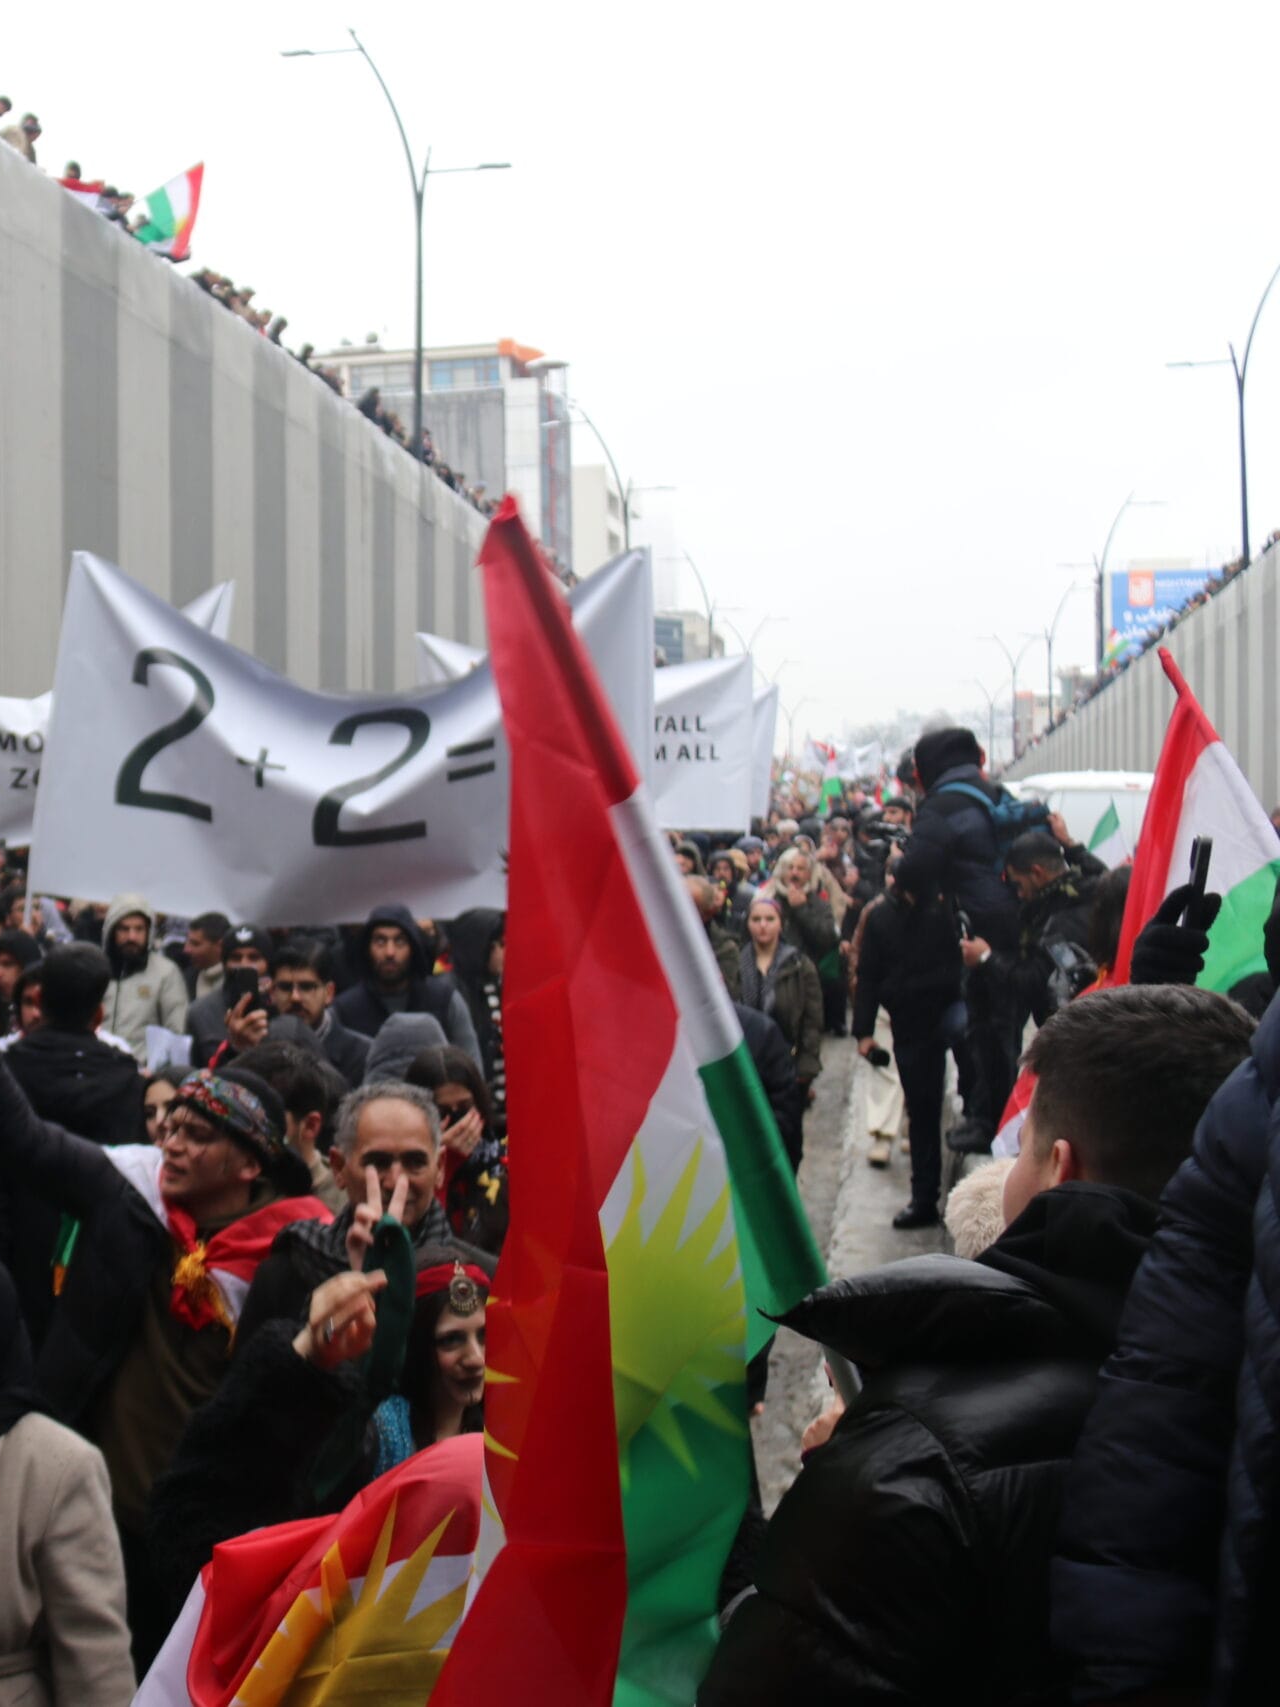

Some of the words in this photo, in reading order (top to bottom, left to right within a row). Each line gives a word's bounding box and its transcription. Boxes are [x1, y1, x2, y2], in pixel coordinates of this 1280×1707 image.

[115, 647, 215, 823] 2
[312, 707, 431, 847] 2
[676, 743, 721, 761] ALL
